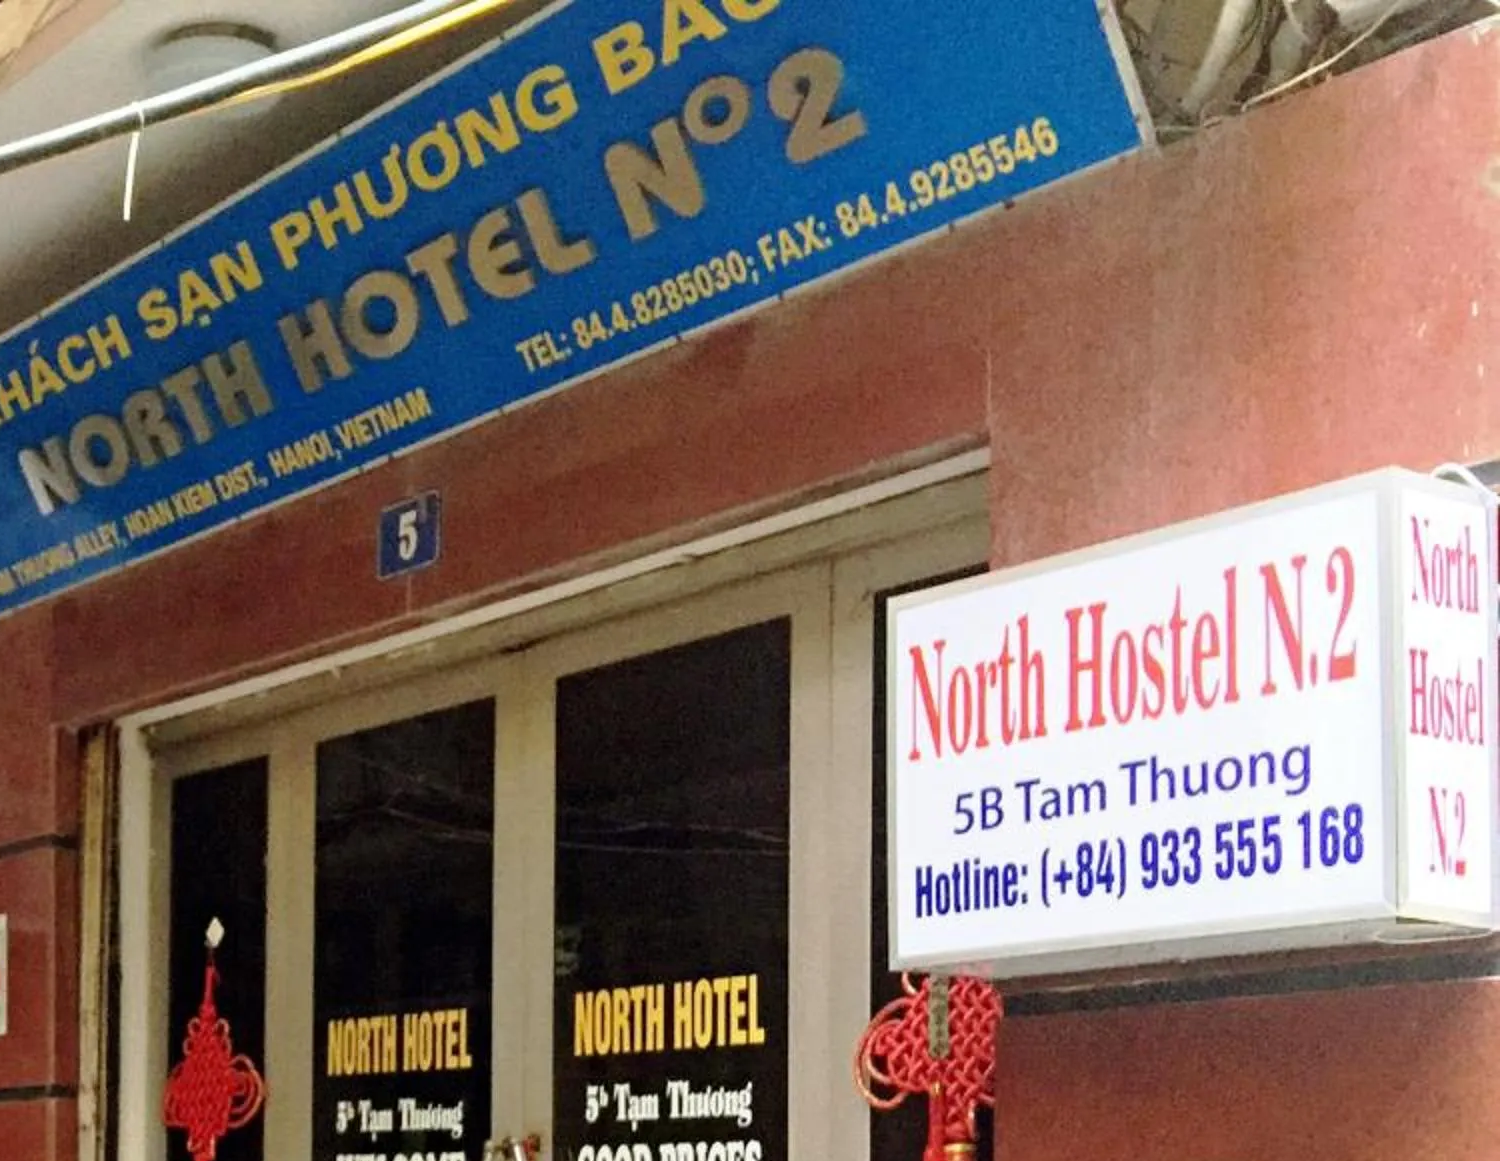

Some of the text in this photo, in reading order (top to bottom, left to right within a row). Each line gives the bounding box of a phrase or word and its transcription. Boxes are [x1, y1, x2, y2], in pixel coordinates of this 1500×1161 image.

[137, 240, 264, 339] SẠN
[269, 64, 579, 270] PHƯƠNG
[515, 332, 572, 372] TEL:
[758, 214, 833, 274] FAX:
[834, 117, 1060, 240] 84.4.9285546
[18, 339, 275, 516] NORTH
[277, 188, 595, 394] HOTEL
[767, 47, 868, 164] 2
[334, 387, 433, 451] VIETNAM
[399, 509, 417, 560] 5
[1410, 514, 1480, 614] North
[908, 545, 1358, 762] North Hostel N.2
[1409, 647, 1485, 747] Hostel
[953, 743, 1312, 835] 5B Tam Thuong
[1428, 785, 1467, 877] N.2
[915, 802, 1365, 918] Hotline: (+84) 933 555 168
[327, 1008, 473, 1076] NORTH HOTEL
[574, 974, 765, 1056] NORTH HOTEL
[613, 1082, 659, 1132] Tạm
